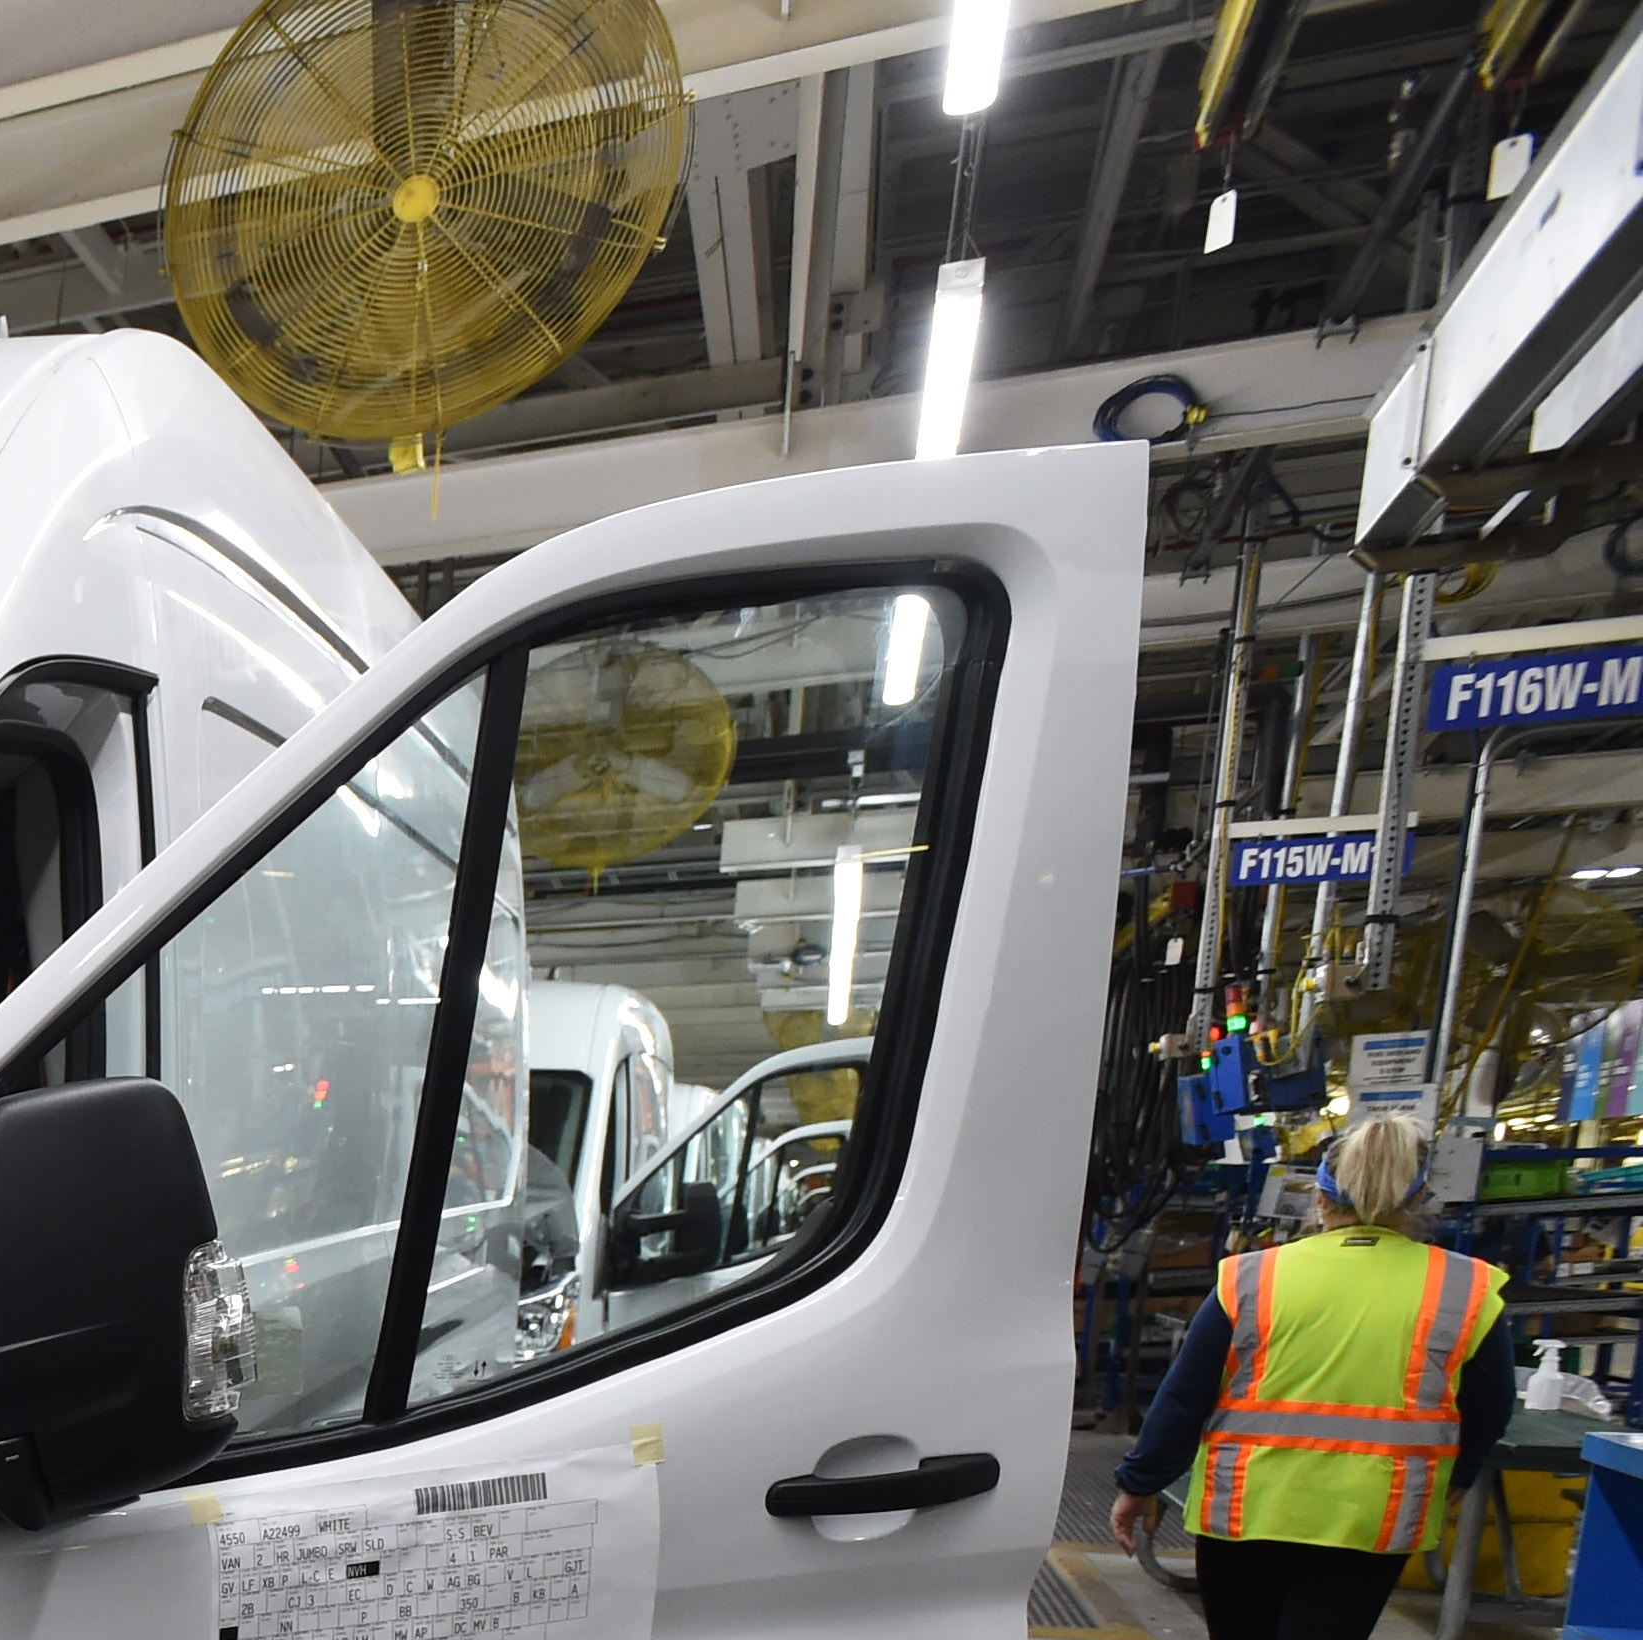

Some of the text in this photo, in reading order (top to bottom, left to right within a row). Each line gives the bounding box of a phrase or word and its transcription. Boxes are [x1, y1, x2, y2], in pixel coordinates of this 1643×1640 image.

[219, 1517, 351, 1546] 4550 A22499 WHITE
[221, 1557, 241, 1571] VAN
[256, 1554, 263, 1566] 2
[276, 1551, 290, 1563] HR
[297, 1545, 328, 1560] JUMBO
[338, 1542, 357, 1556] SRW
[364, 1538, 385, 1552] SLD
[473, 1524, 493, 1537] BEV
[221, 1582, 235, 1594] GV
[242, 1578, 255, 1592] LF
[262, 1577, 275, 1589] XB
[281, 1575, 289, 1587] P
[328, 1568, 334, 1580] E
[347, 1564, 367, 1578] NVH
[449, 1552, 456, 1563] 4
[489, 1546, 509, 1559] PAR
[288, 1597, 301, 1609] CJ
[308, 1595, 315, 1606] 3
[348, 1588, 361, 1601] EC
[406, 1581, 413, 1593] C
[426, 1579, 434, 1591] W
[447, 1576, 461, 1588] AG
[467, 1574, 481, 1586] BG
[507, 1569, 514, 1581] V
[526, 1567, 532, 1578] L
[564, 1560, 584, 1573] GJT
[280, 1621, 293, 1633] NN
[361, 1612, 368, 1623] P
[459, 1597, 478, 1611] 350
[571, 1584, 578, 1595] A
[394, 1630, 408, 1640] MW
[414, 1627, 428, 1639] AP
[454, 1622, 467, 1634] DC
[473, 1620, 487, 1631] MV
